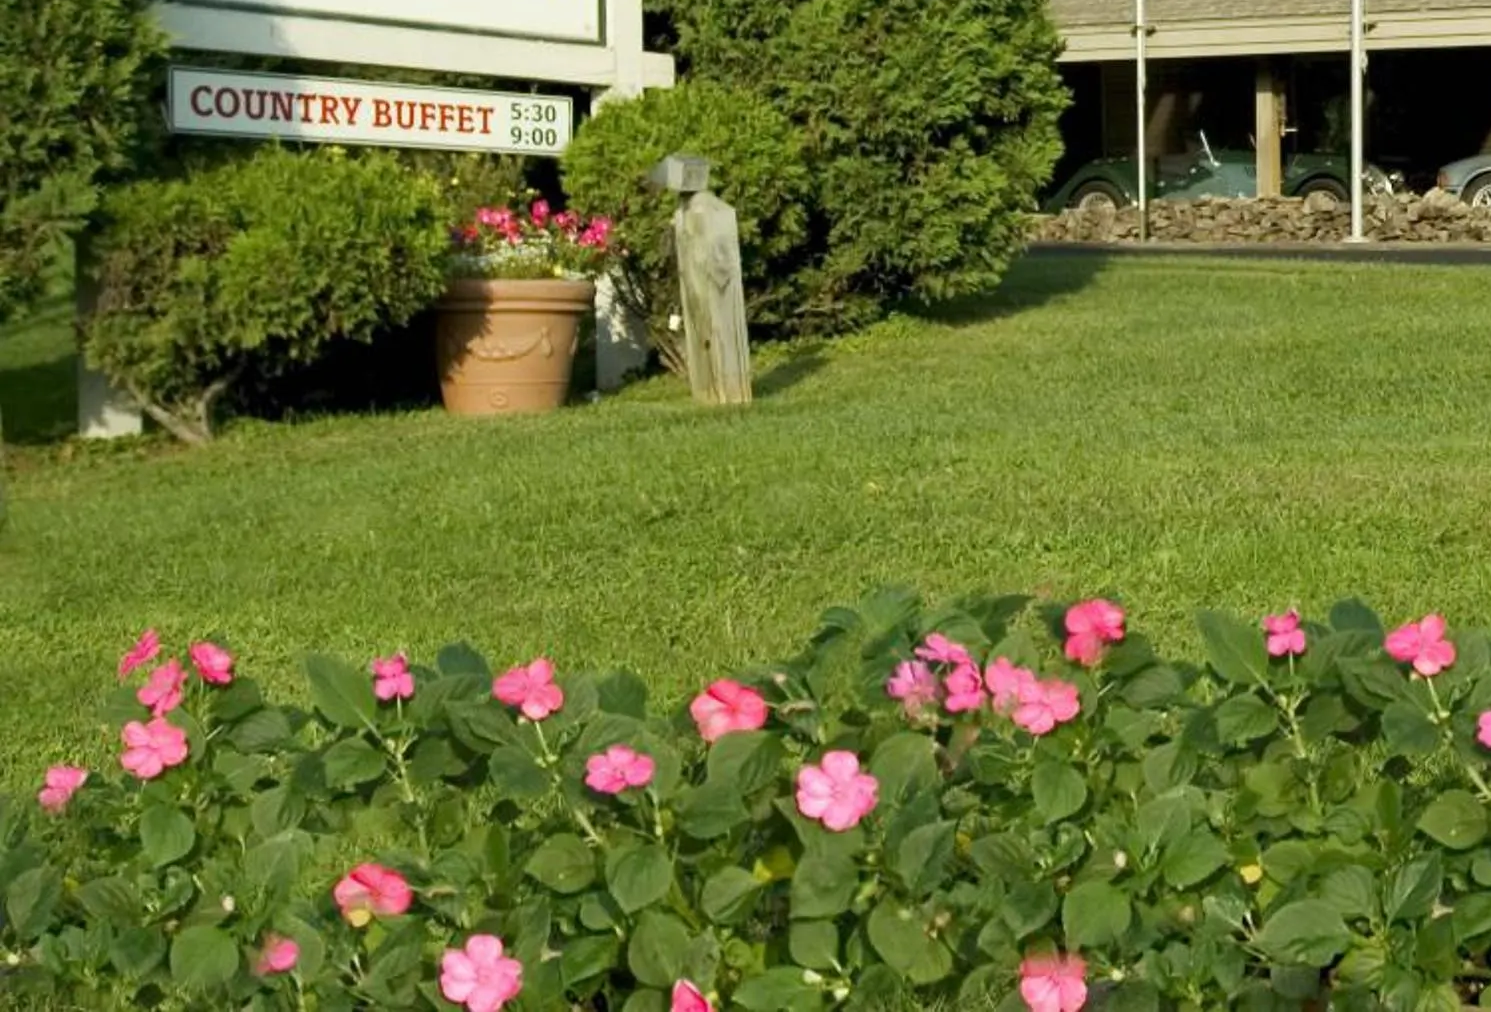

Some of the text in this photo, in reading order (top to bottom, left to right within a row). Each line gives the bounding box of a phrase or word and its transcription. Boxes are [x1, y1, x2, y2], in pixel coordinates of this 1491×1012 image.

[190, 85, 495, 135] COUNTRY BUFFET
[510, 103, 557, 124] 5:30
[510, 126, 558, 147] 9:00
